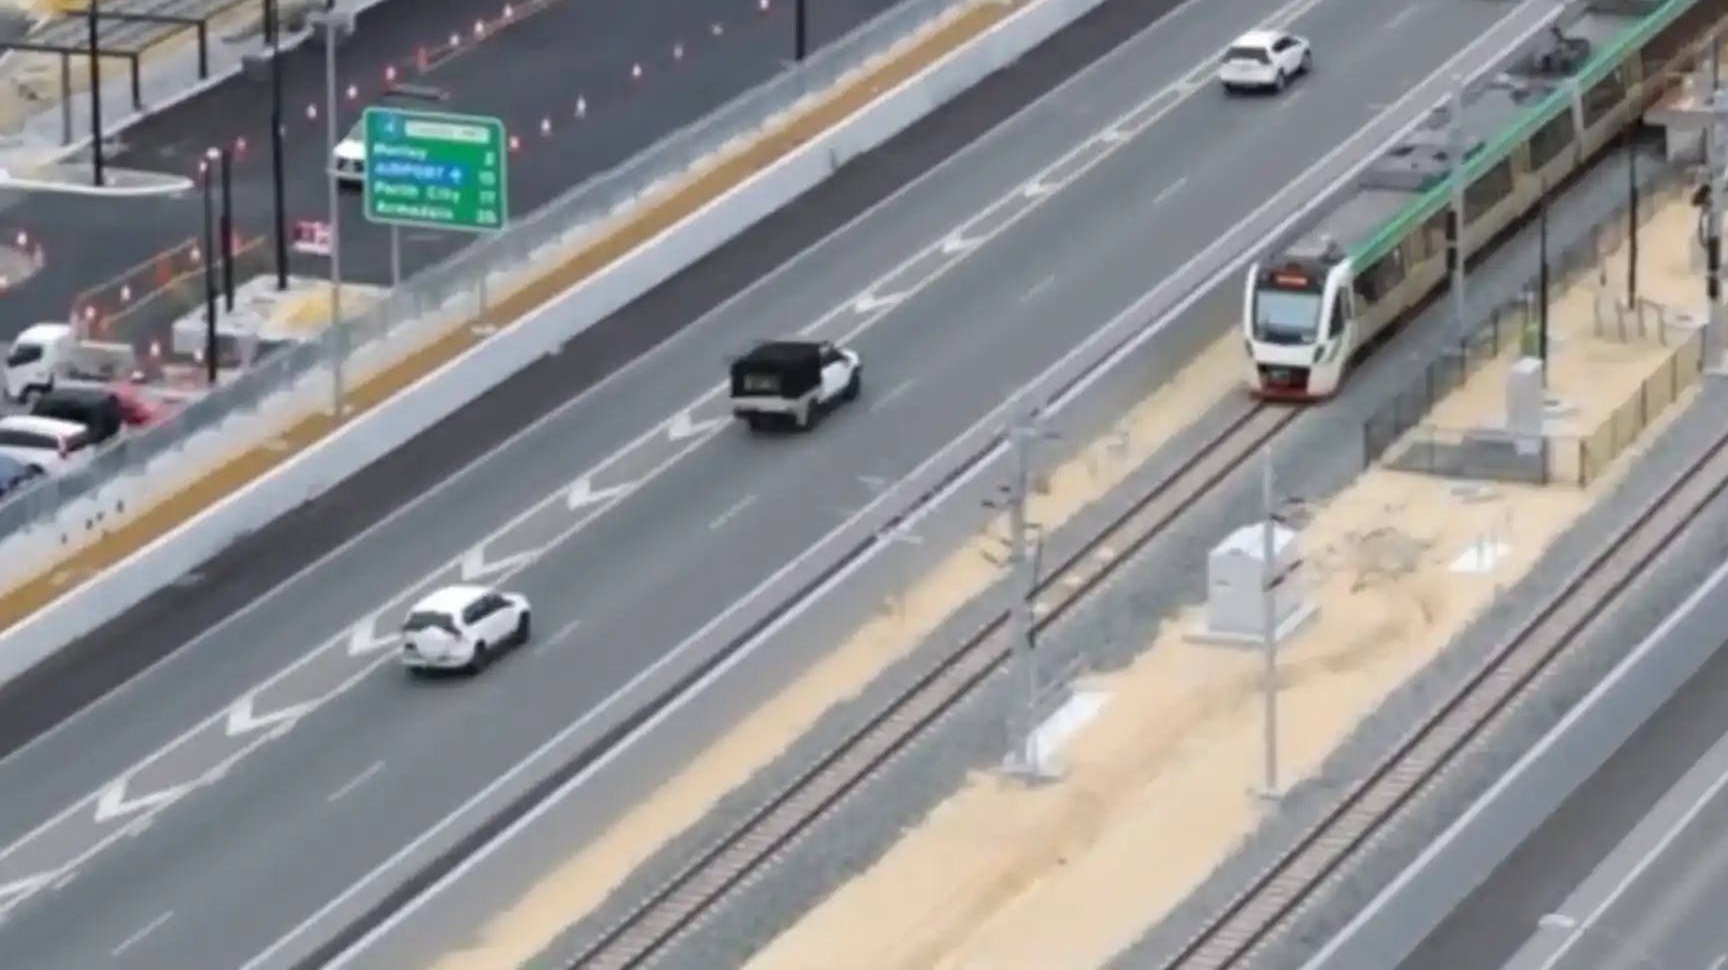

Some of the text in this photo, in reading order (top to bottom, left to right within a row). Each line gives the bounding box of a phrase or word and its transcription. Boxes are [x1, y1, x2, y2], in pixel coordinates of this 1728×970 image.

[373, 143, 428, 161] Morley
[374, 162, 445, 180] AIRPORT
[373, 181, 461, 205] Perth City
